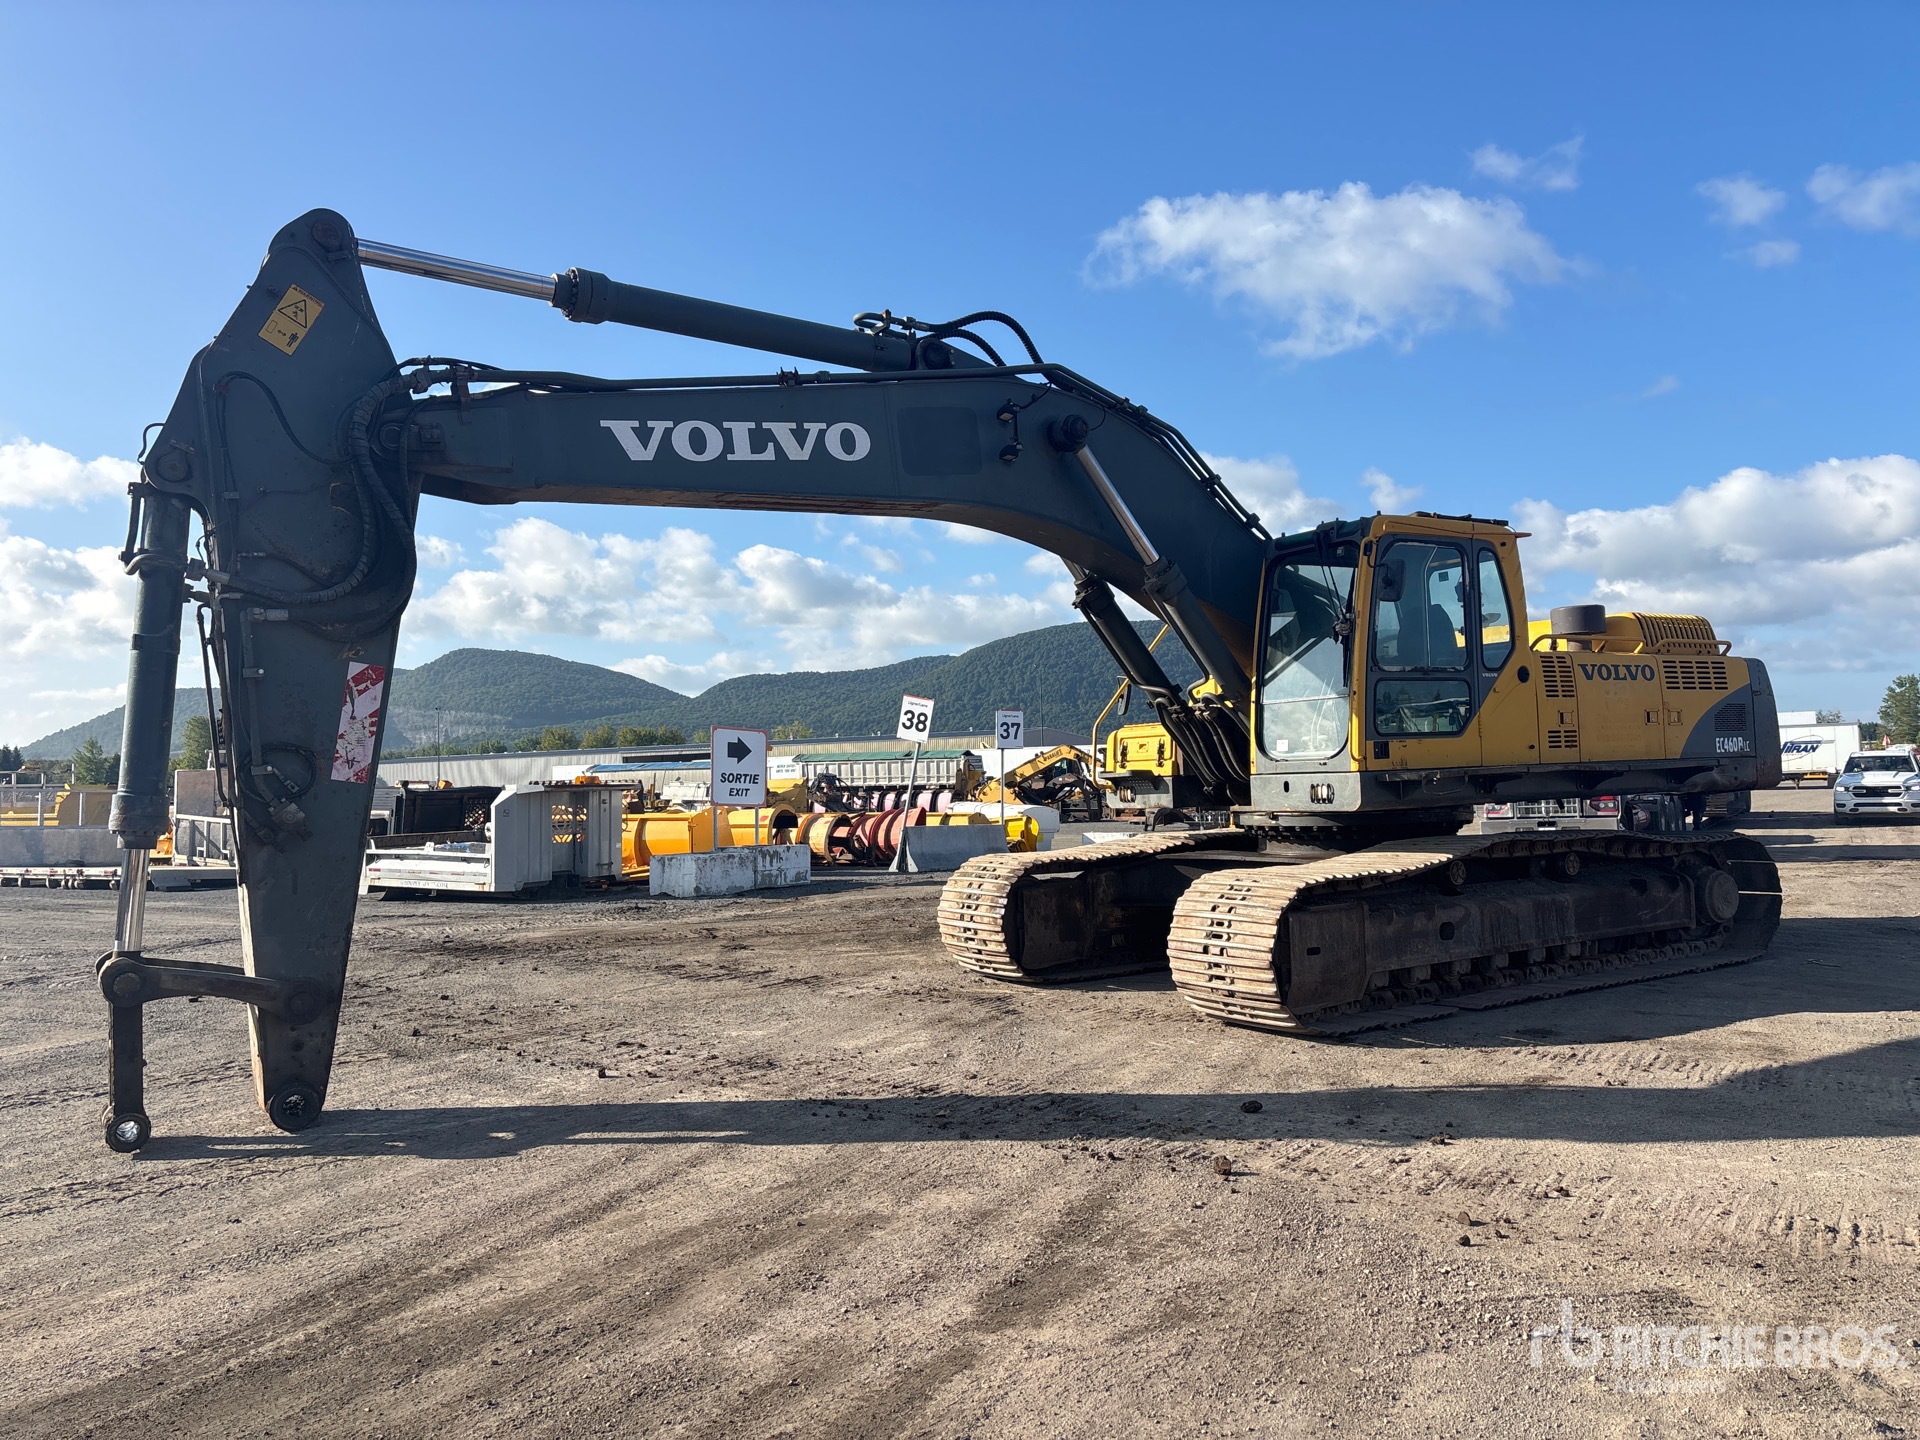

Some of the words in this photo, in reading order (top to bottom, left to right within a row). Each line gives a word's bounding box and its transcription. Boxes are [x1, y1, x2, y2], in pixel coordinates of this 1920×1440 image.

[600, 420, 871, 461] VOLVO
[1578, 663, 1655, 681] VOLVO
[901, 709, 928, 732] 38
[1000, 722, 1020, 740] 37
[720, 772, 760, 784] SORTIE
[728, 787, 750, 797] EXIT
